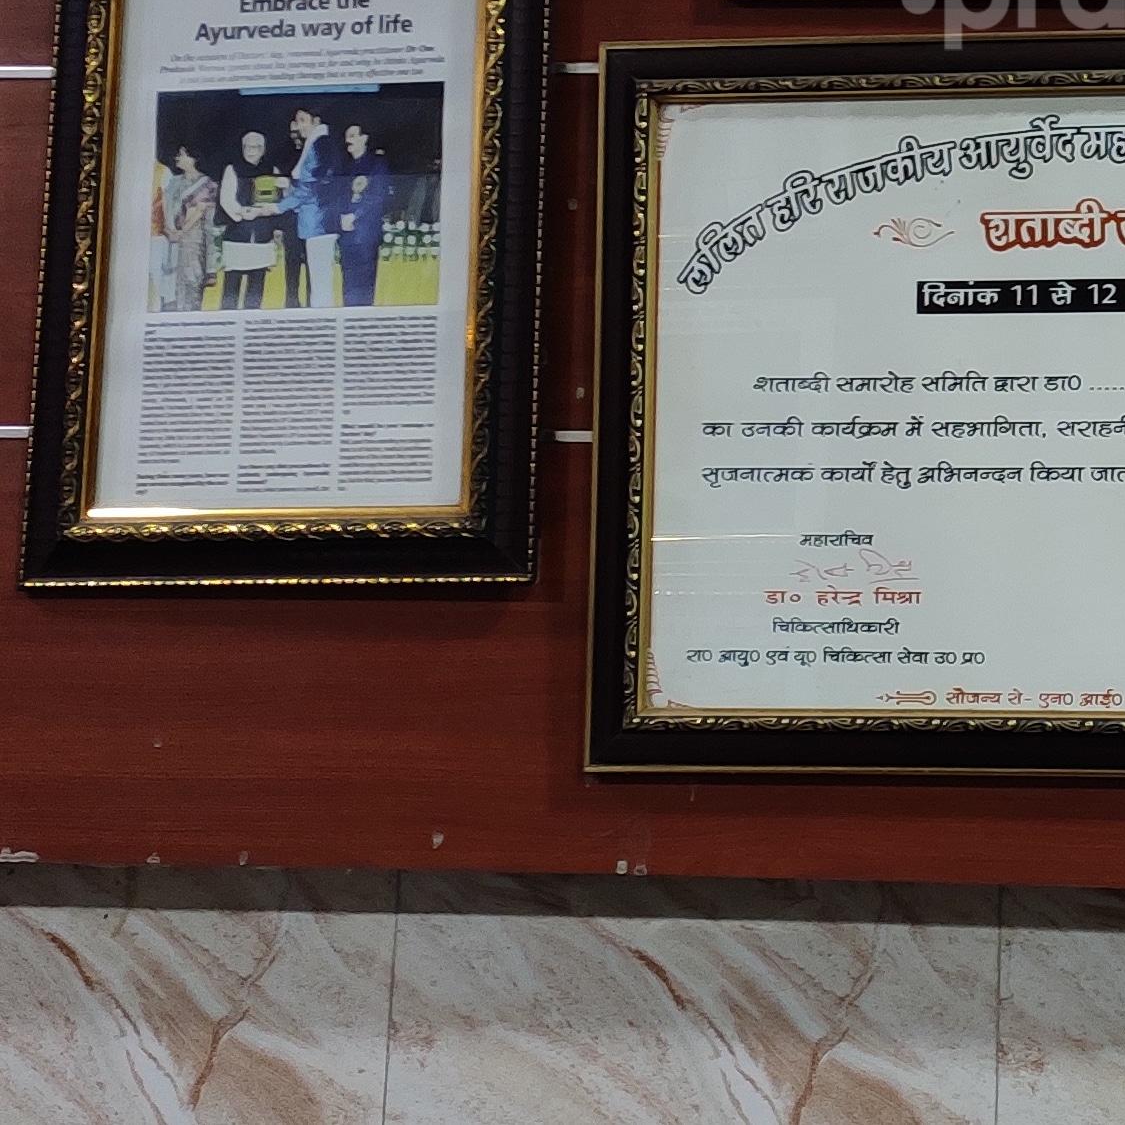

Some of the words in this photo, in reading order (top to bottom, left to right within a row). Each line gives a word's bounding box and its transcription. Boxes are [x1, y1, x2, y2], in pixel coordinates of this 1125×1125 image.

[194, 21, 295, 45] Ayurveda
[301, 21, 345, 41] way
[351, 15, 373, 34] of
[379, 14, 414, 34] life
[677, 202, 766, 295] ललित
[764, 169, 824, 233] हरि
[821, 135, 960, 204] राजकीय
[979, 197, 1108, 252] शताब्दी
[921, 281, 1001, 309] दिनांक
[1009, 284, 1040, 306] 11
[1049, 281, 1076, 306] से
[1088, 283, 1117, 305] 12
[752, 371, 830, 393] शताब्दी
[836, 370, 915, 393] समारोह
[922, 371, 988, 393] समिति
[993, 376, 1038, 393] द्वारा
[701, 421, 733, 438] का
[741, 416, 804, 438] उनकी
[811, 415, 899, 439] कार्यक्रम
[905, 415, 925, 437] में
[931, 415, 1046, 439] सहभागिता,
[701, 465, 814, 488] सृजनात्मक
[820, 461, 877, 483] कार्यों
[880, 462, 913, 490] हेतु
[917, 461, 1024, 484] अभिनन्दन
[1029, 461, 1084, 484] किया
[816, 584, 864, 608] हरेन्द्र
[873, 586, 922, 606] मिश्रा
[772, 617, 900, 636] चिकित्साधिकारी
[765, 646, 789, 663] एवं
[823, 647, 892, 664] चिकित्सा
[897, 647, 929, 664] सेवा
[945, 687, 1002, 704] सौजन्य
